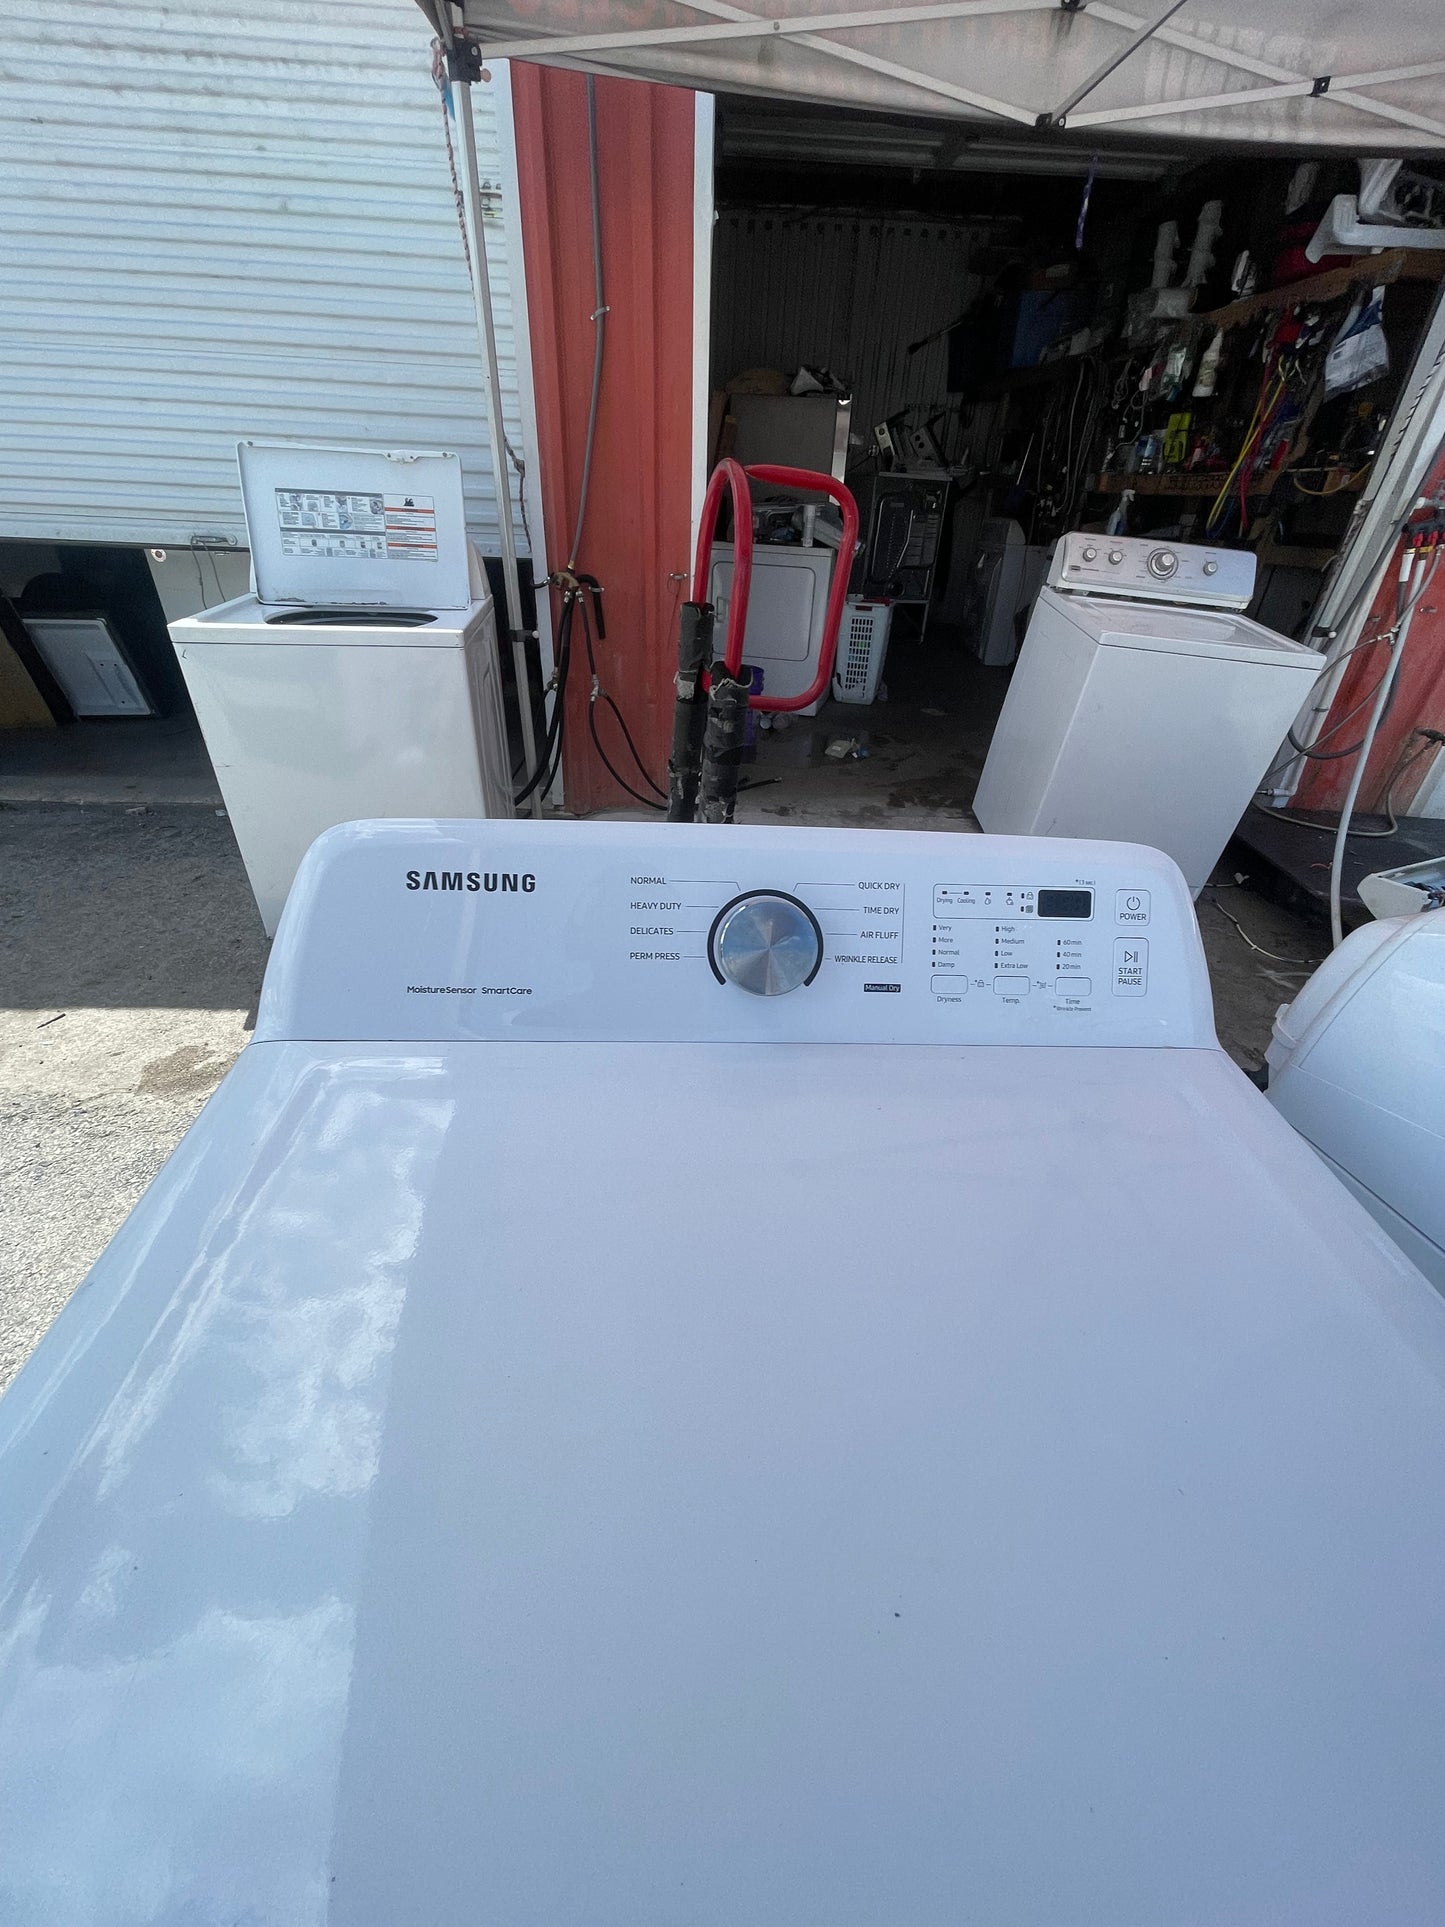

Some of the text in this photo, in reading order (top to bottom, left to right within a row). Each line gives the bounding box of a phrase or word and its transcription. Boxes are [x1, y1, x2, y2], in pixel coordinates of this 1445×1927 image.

[406, 871, 536, 892] SAMSUNG
[630, 876, 667, 885] NORMAL
[858, 881, 900, 890] QUICK DRY
[630, 902, 681, 910] HEAVY DUTY
[863, 906, 899, 915] TIME DRY
[1119, 912, 1147, 921] POWER
[630, 926, 674, 936] DELICATES
[938, 924, 952, 932] Very
[860, 931, 899, 939] AIR FLUFF
[629, 952, 681, 960] PERM PRESS
[834, 955, 898, 964] WRINKLE RELEASE
[937, 961, 955, 969] Damp
[1118, 967, 1143, 975] START
[1117, 978, 1142, 986] PAUSE
[406, 986, 533, 995] MoistureSensor SmartCare
[865, 983, 900, 992] Manual Dry
[936, 996, 962, 1004] Dryness
